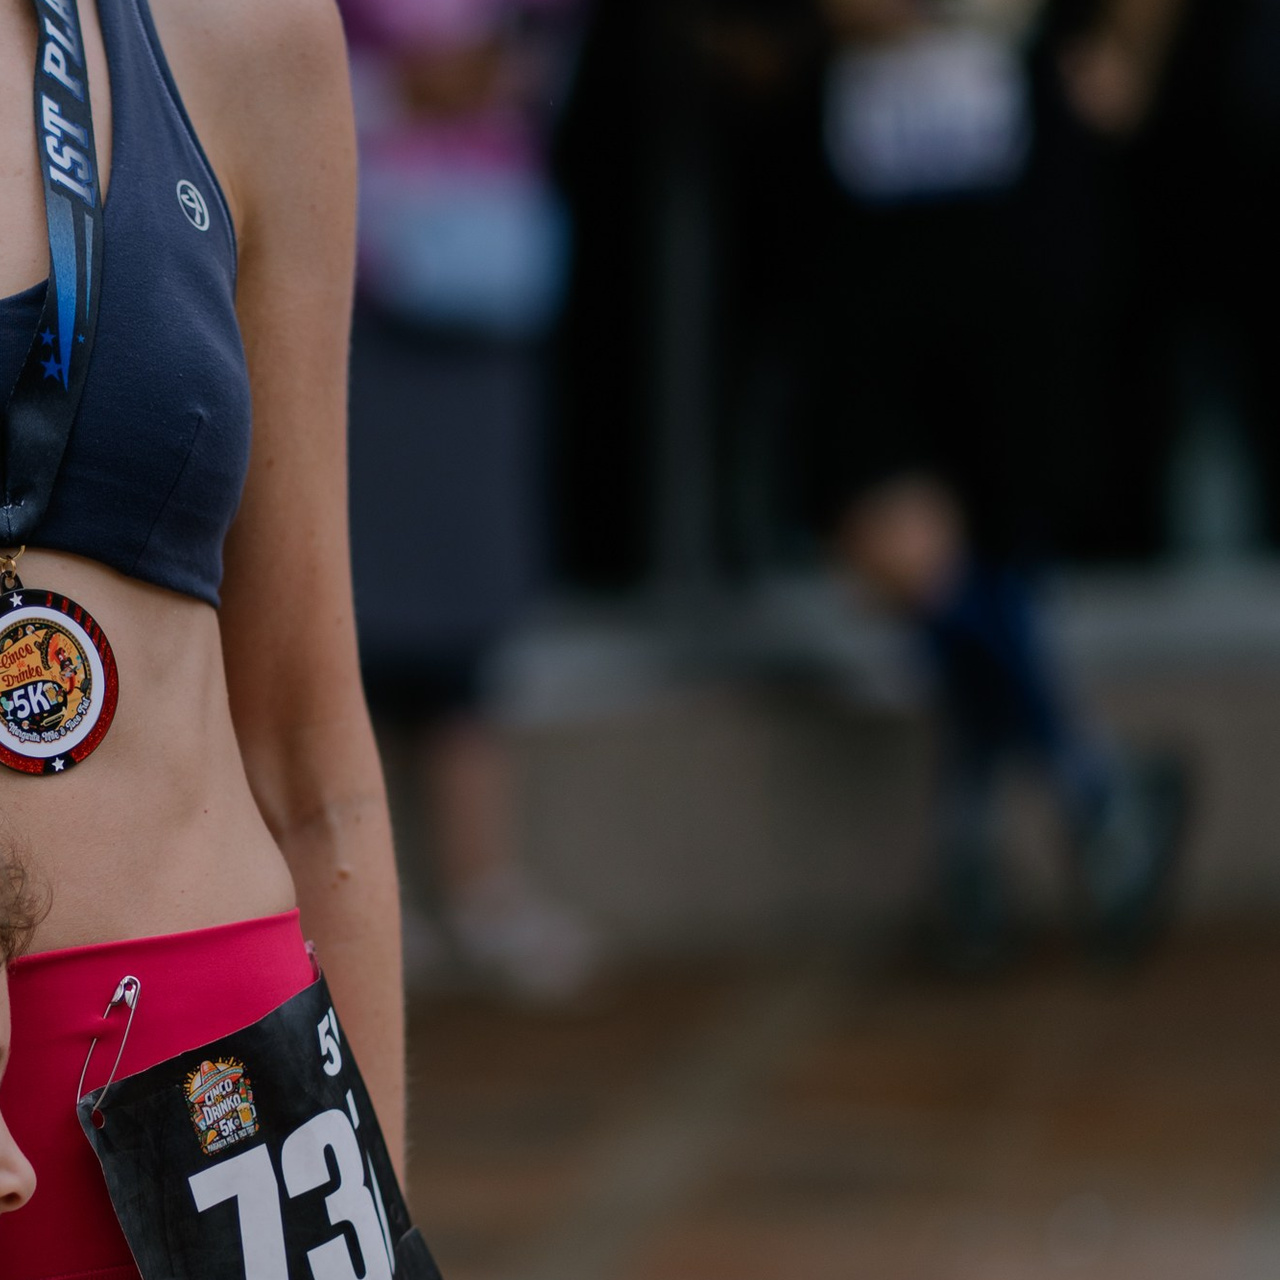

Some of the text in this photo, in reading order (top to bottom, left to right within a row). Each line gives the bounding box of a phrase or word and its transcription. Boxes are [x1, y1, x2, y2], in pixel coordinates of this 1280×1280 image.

[2, 664, 44, 687] Drinko
[13, 682, 51, 718] 5K
[204, 1078, 233, 1106] CINCO
[202, 1093, 241, 1126] DRINKO
[220, 1118, 236, 1136] 5K
